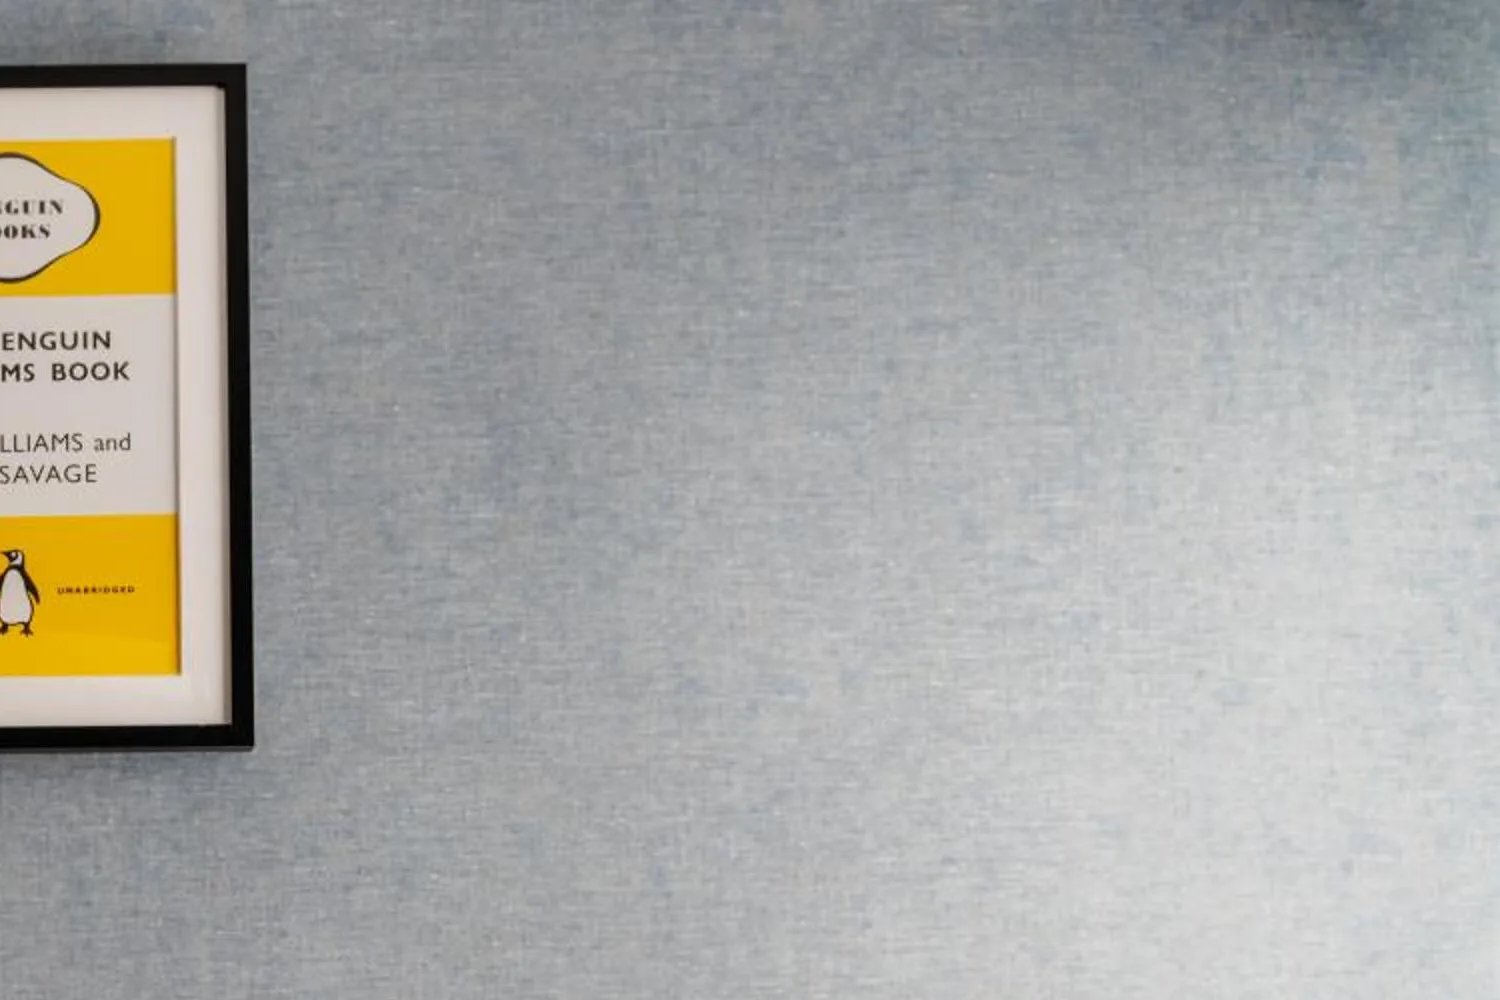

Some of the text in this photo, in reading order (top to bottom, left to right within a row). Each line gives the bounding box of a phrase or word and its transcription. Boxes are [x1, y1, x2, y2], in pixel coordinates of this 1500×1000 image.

[51, 361, 130, 382] BOOK
[93, 431, 132, 453] and
[56, 585, 136, 596] UNABRIDGED
